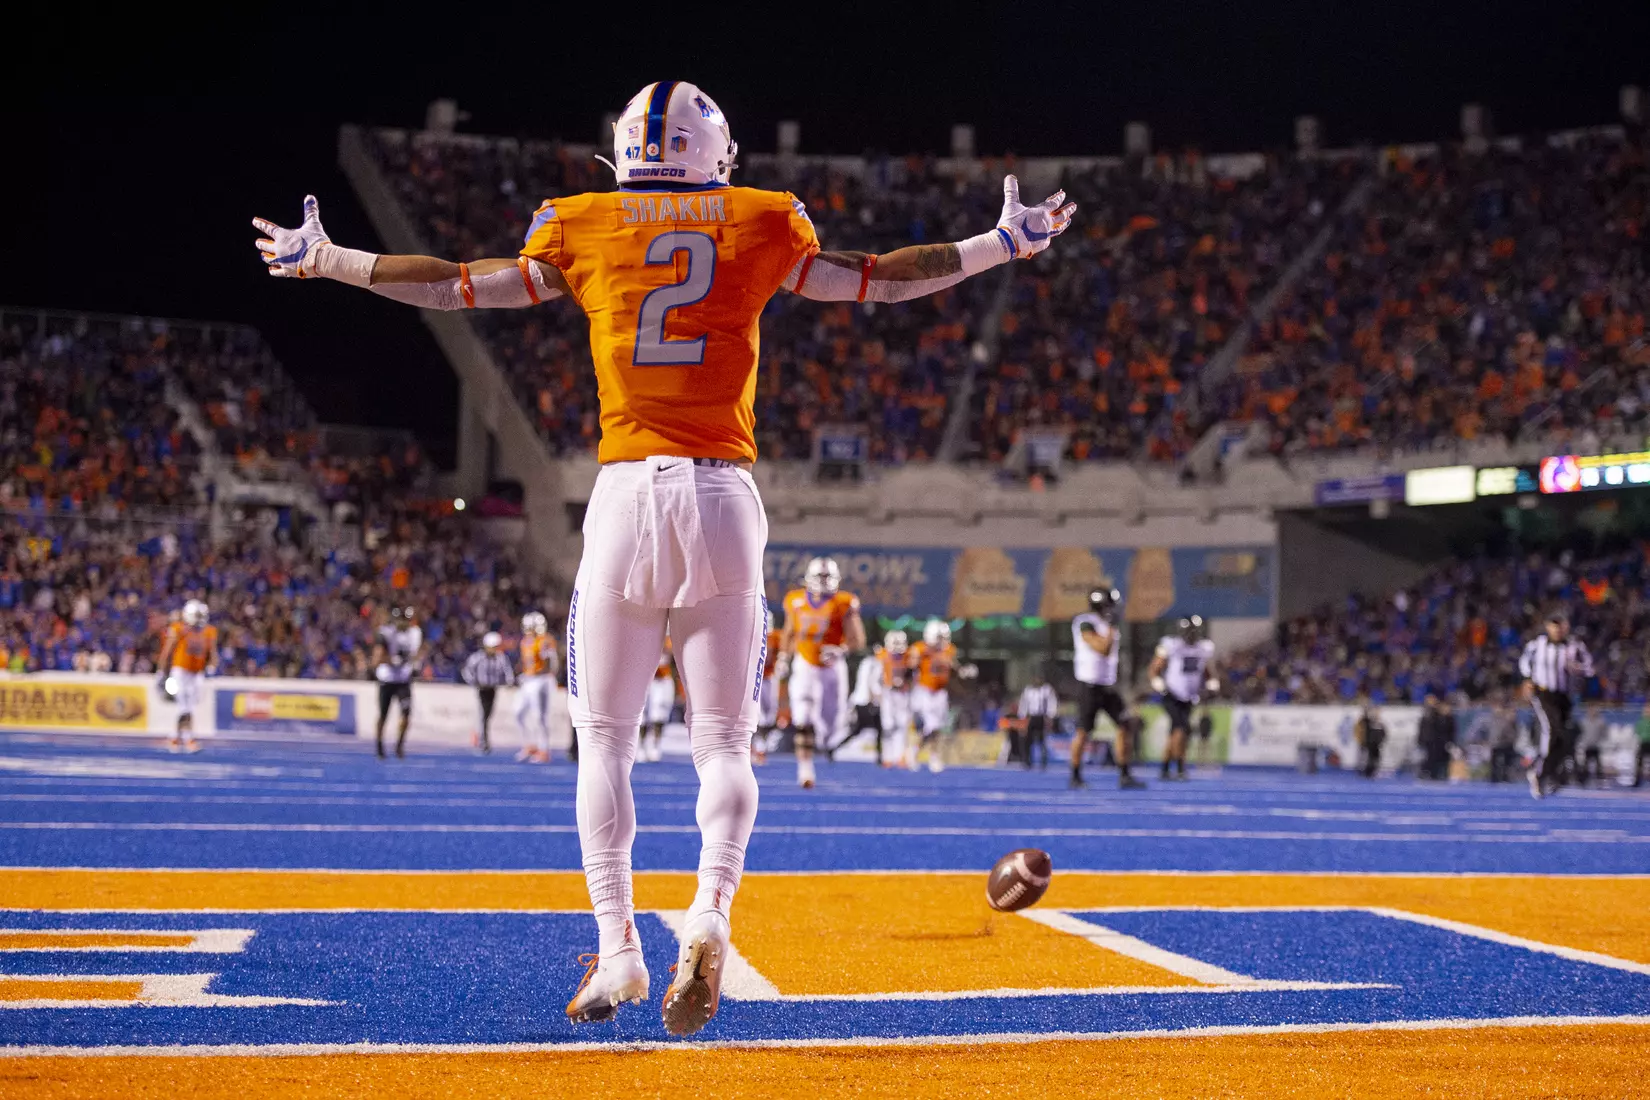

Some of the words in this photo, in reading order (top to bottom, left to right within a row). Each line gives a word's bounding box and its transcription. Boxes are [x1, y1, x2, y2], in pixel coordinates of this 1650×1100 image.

[621, 195, 726, 223] SHAKIR
[628, 168, 687, 178] BRONCOS
[632, 230, 717, 367] 2
[567, 587, 579, 698] BRONCOS
[752, 593, 768, 703] BRONCOS
